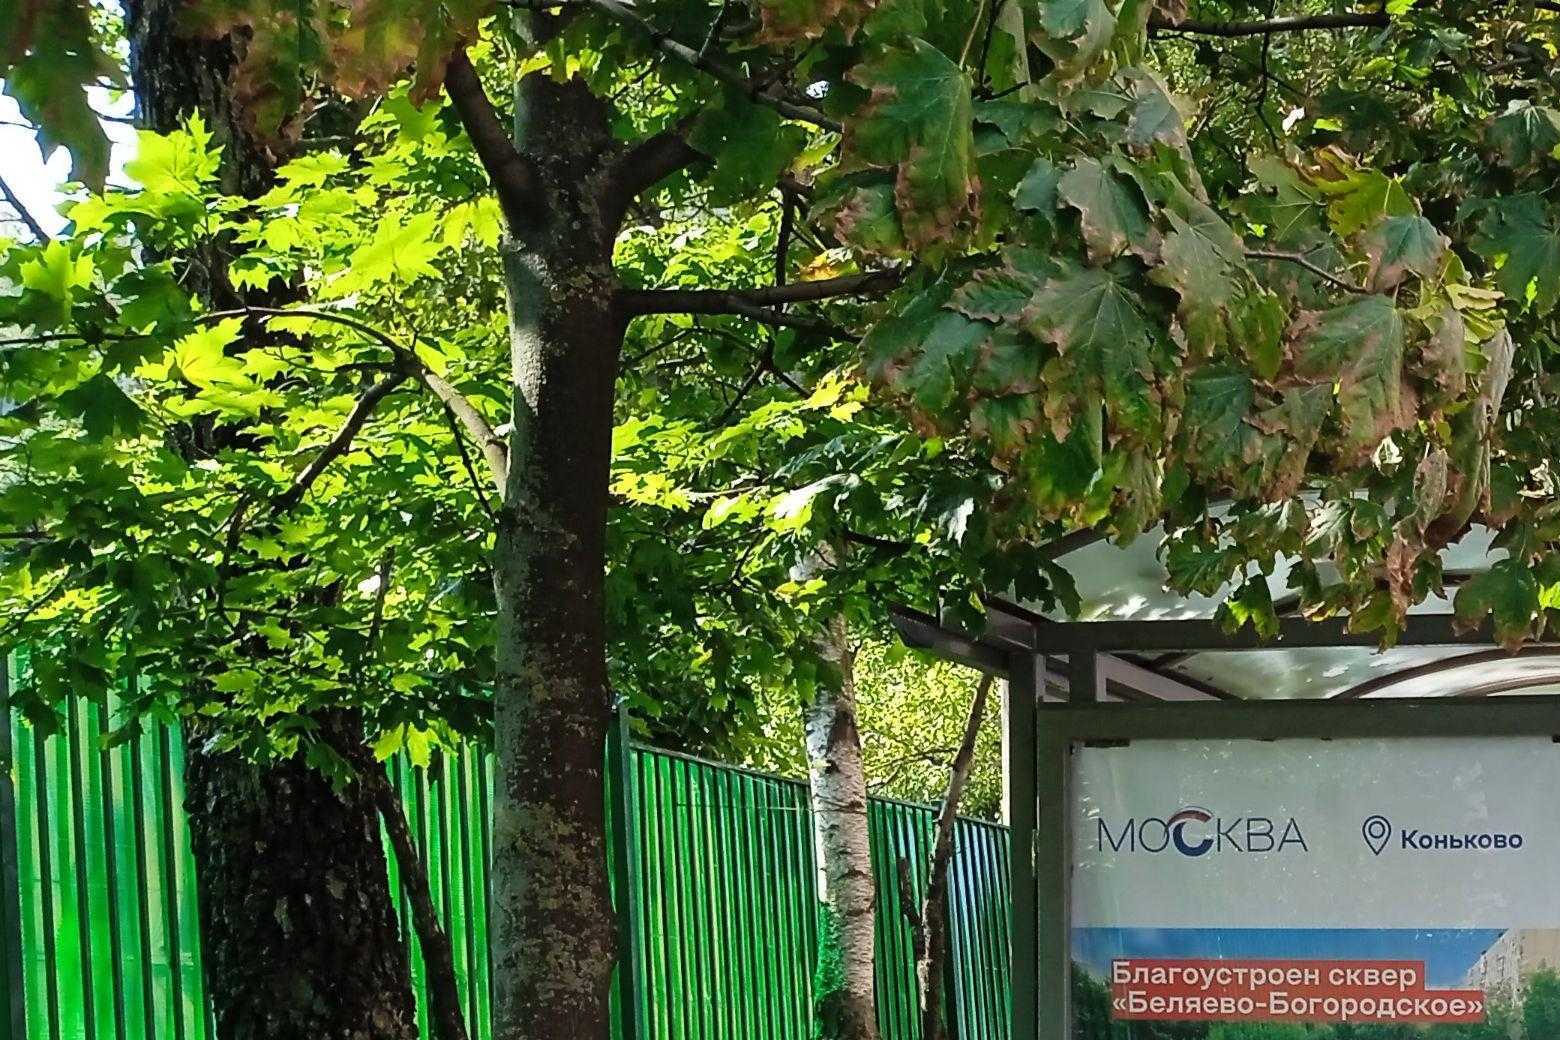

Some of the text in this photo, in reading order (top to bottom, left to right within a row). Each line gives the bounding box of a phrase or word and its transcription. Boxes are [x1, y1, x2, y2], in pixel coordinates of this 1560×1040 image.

[1098, 806, 1308, 857] МОСКВА
[1401, 829, 1523, 850] Коньково
[1112, 961, 1416, 991] Благоустроен сквер
[1113, 990, 1484, 1020] «Беляево-Богородское»
